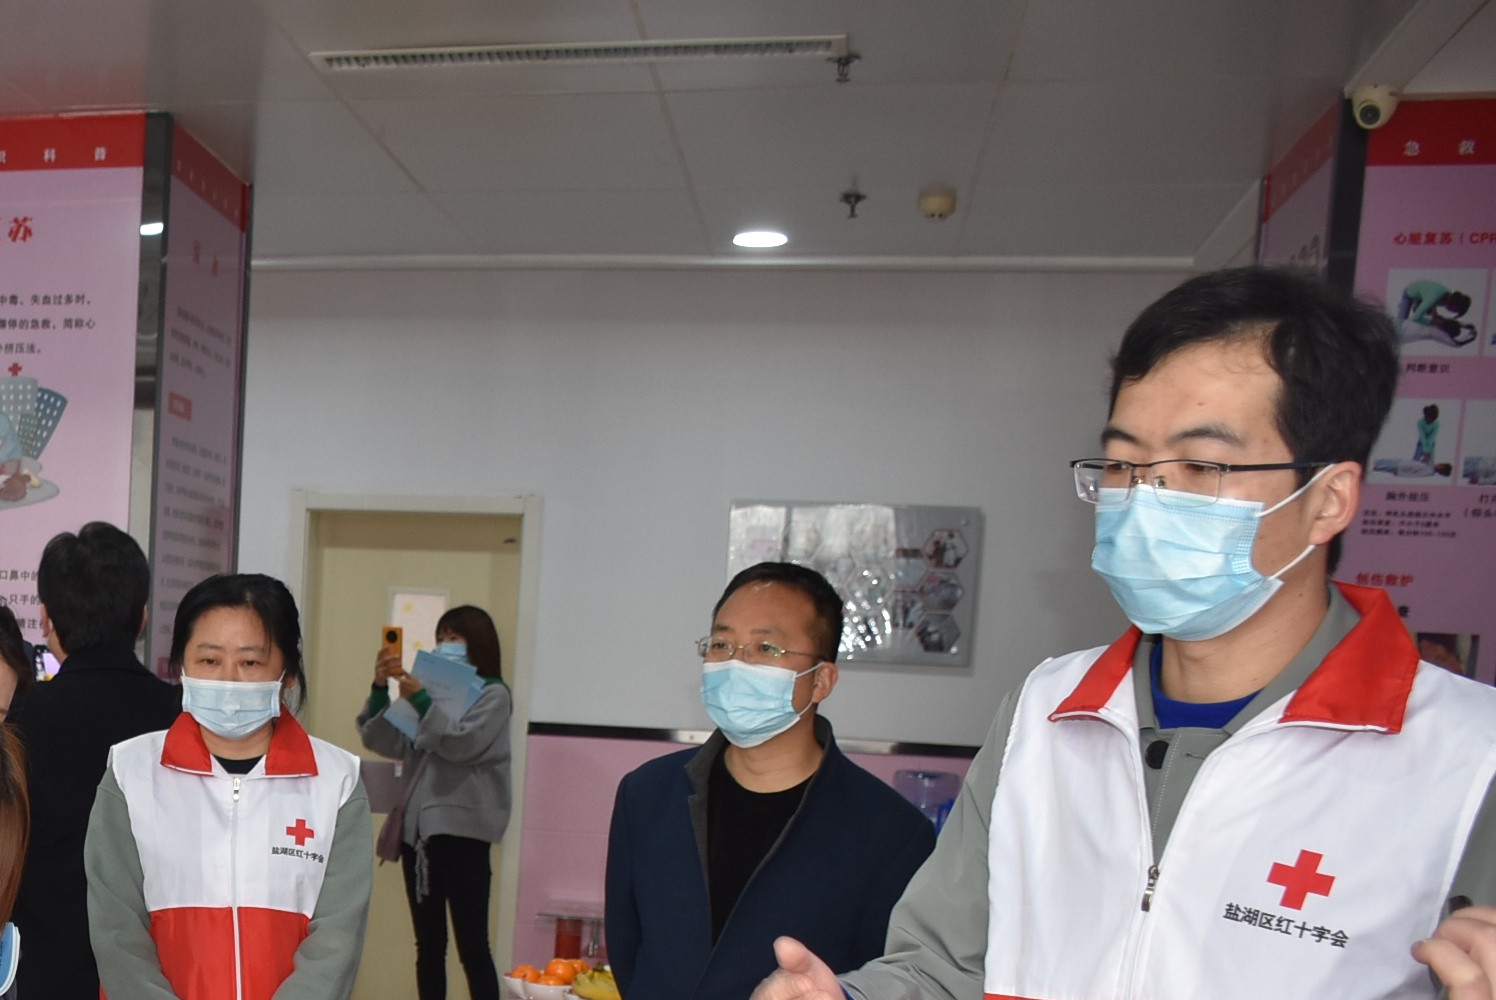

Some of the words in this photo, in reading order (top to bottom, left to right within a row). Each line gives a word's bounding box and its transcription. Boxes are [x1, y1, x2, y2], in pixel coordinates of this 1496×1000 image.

[271, 846, 325, 863] 盐湖区红十字会
[1222, 902, 1349, 948] 盐湖区红十字会
